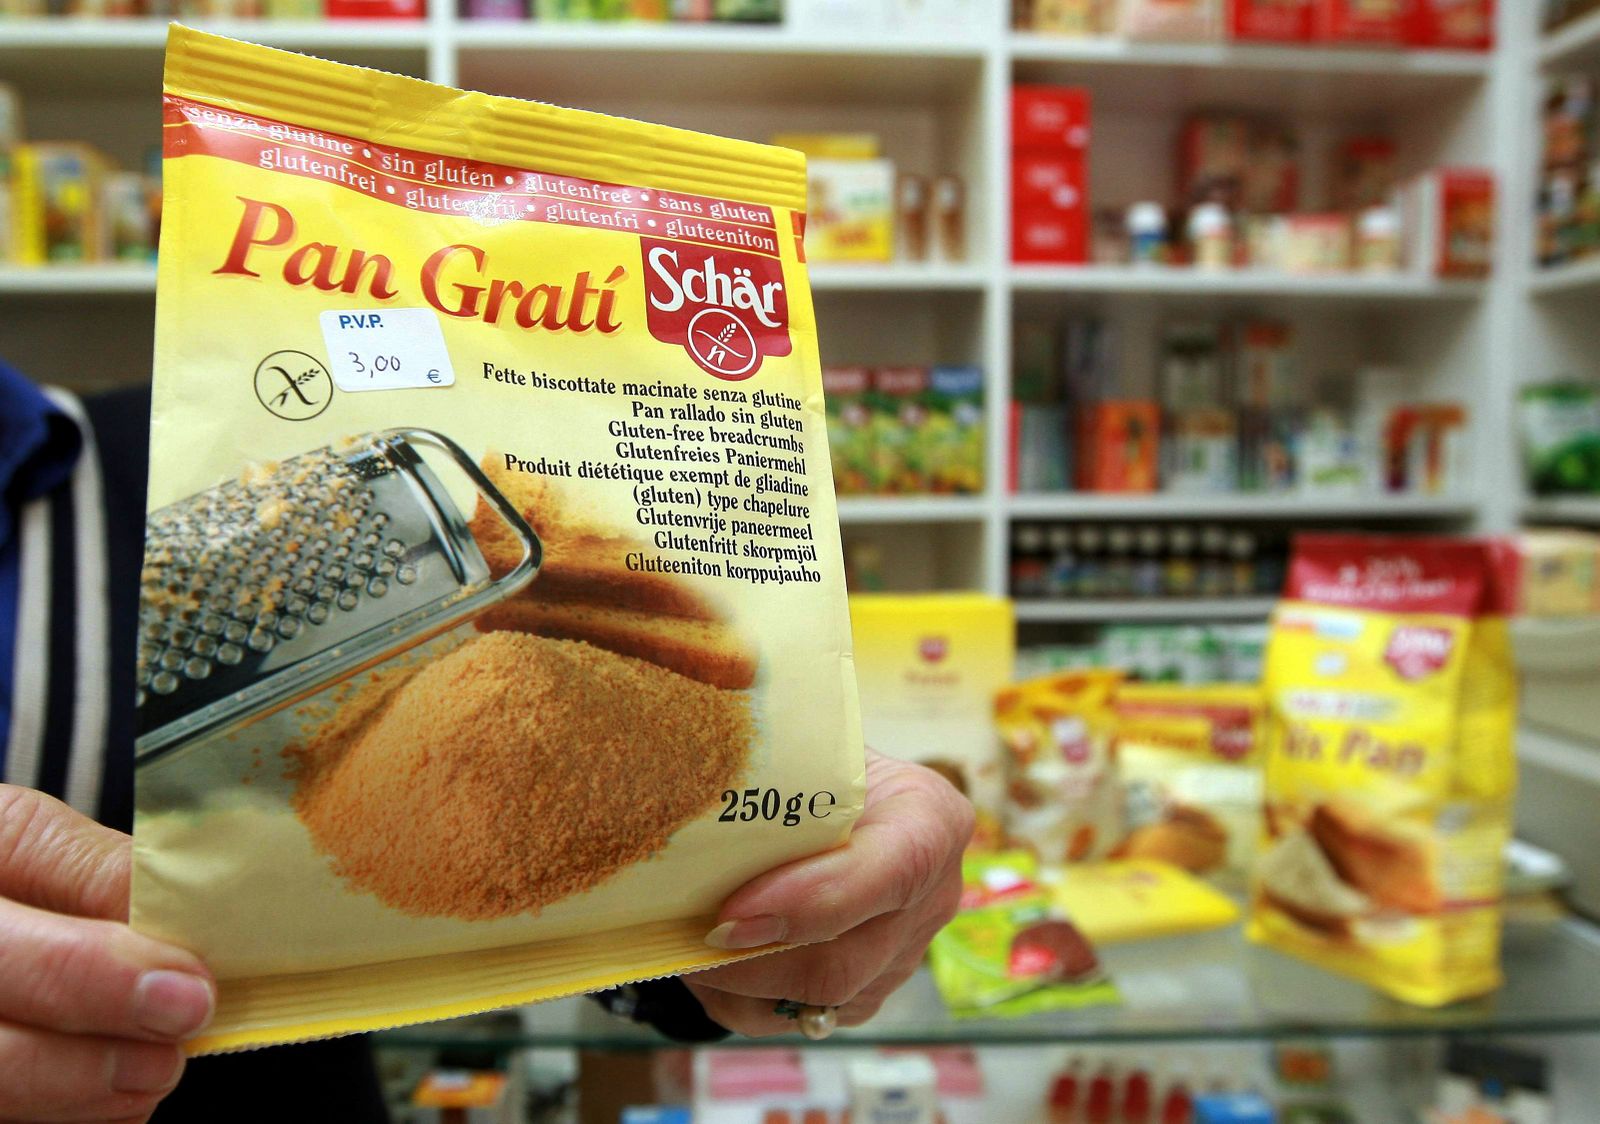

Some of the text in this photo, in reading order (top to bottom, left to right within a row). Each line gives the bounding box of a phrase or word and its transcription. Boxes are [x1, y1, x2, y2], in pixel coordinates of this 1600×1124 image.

[189, 106, 771, 224] senza glutine sin gluten glutenfree sans gluten
[259, 147, 377, 194] glutenfrei
[546, 203, 639, 229] glutenfri
[666, 219, 775, 251] gluteeniton
[211, 195, 626, 334] Pan Gratí
[648, 247, 783, 328] Schär
[338, 314, 384, 329] P.V.P.
[348, 352, 442, 383] 3,00 €
[483, 362, 802, 411] Fette biscottate macinate senza glutine
[632, 401, 803, 432] Pan rallado sin gluten
[608, 420, 804, 454] Gluten-free breadcrumbs
[504, 453, 809, 497] Produit diététique exempt de gliadine
[615, 442, 807, 475] Glutenfreies Paniermehl
[633, 484, 810, 519] (gluten) type chapelure
[636, 507, 814, 540] Glutenvrije paneermeel
[654, 531, 818, 564] Glutenfritt skorpmjöl
[625, 552, 821, 585] Gluteeniton korppujauho
